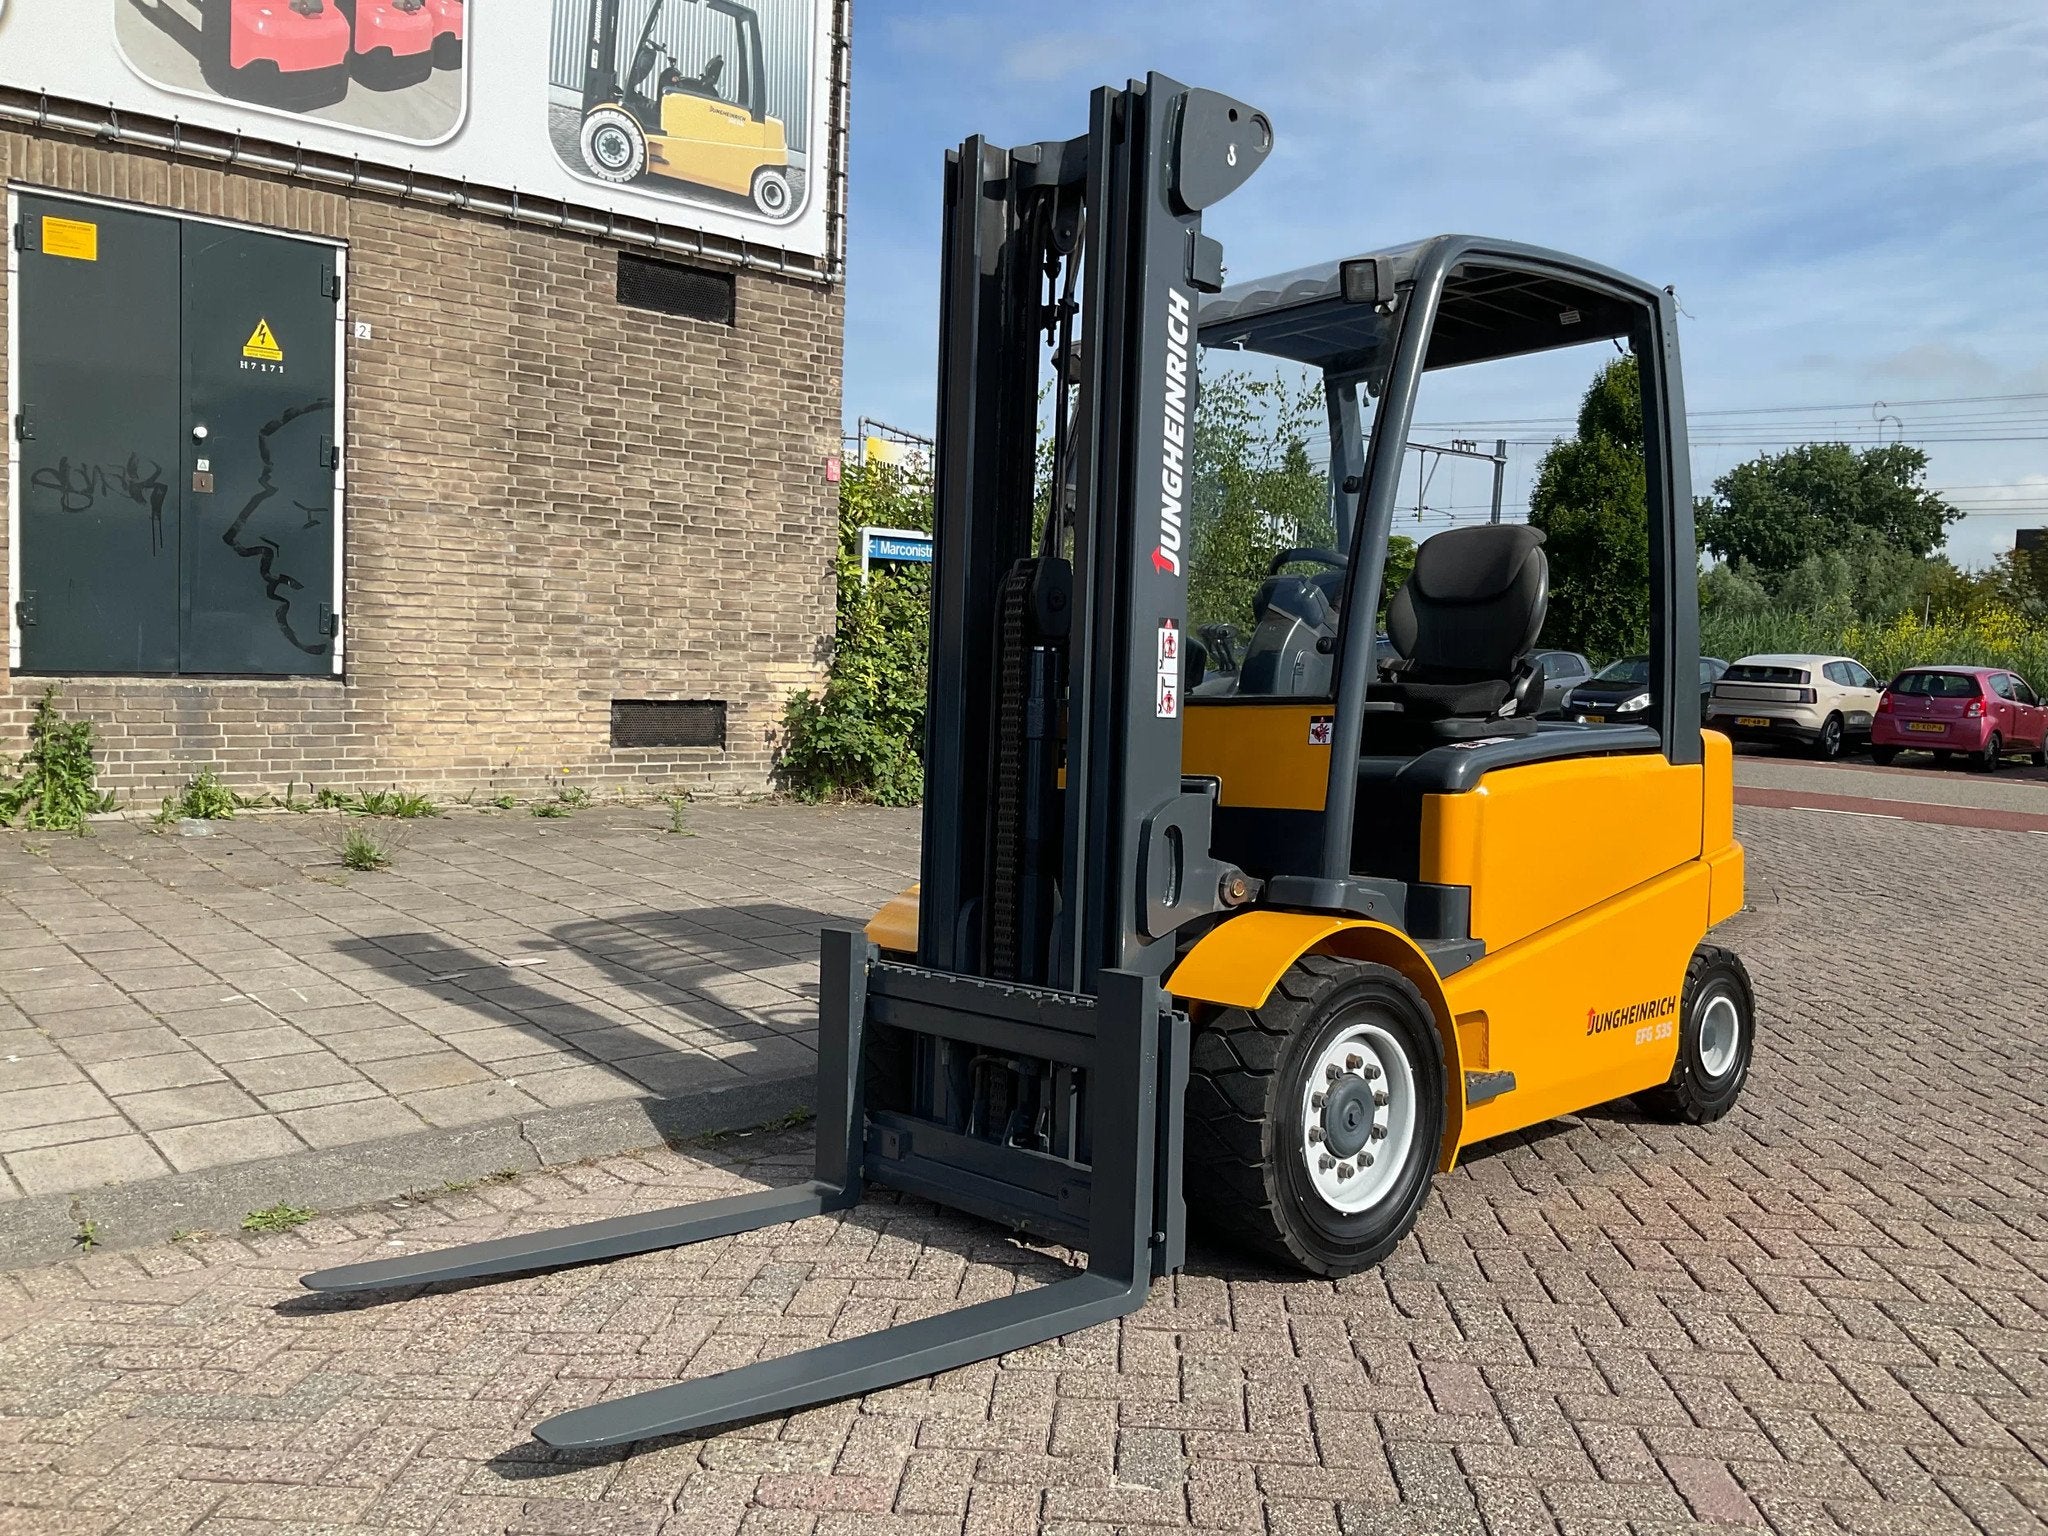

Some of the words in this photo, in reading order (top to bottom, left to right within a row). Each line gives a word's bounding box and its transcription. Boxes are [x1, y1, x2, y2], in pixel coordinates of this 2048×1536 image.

[359, 325, 366, 338] 2
[1152, 287, 1190, 577] JUNGHEINRICH
[1586, 995, 1676, 1036] JUNGHEINRICH
[1635, 1025, 1653, 1046] EFG
[1655, 1020, 1673, 1041] 535
